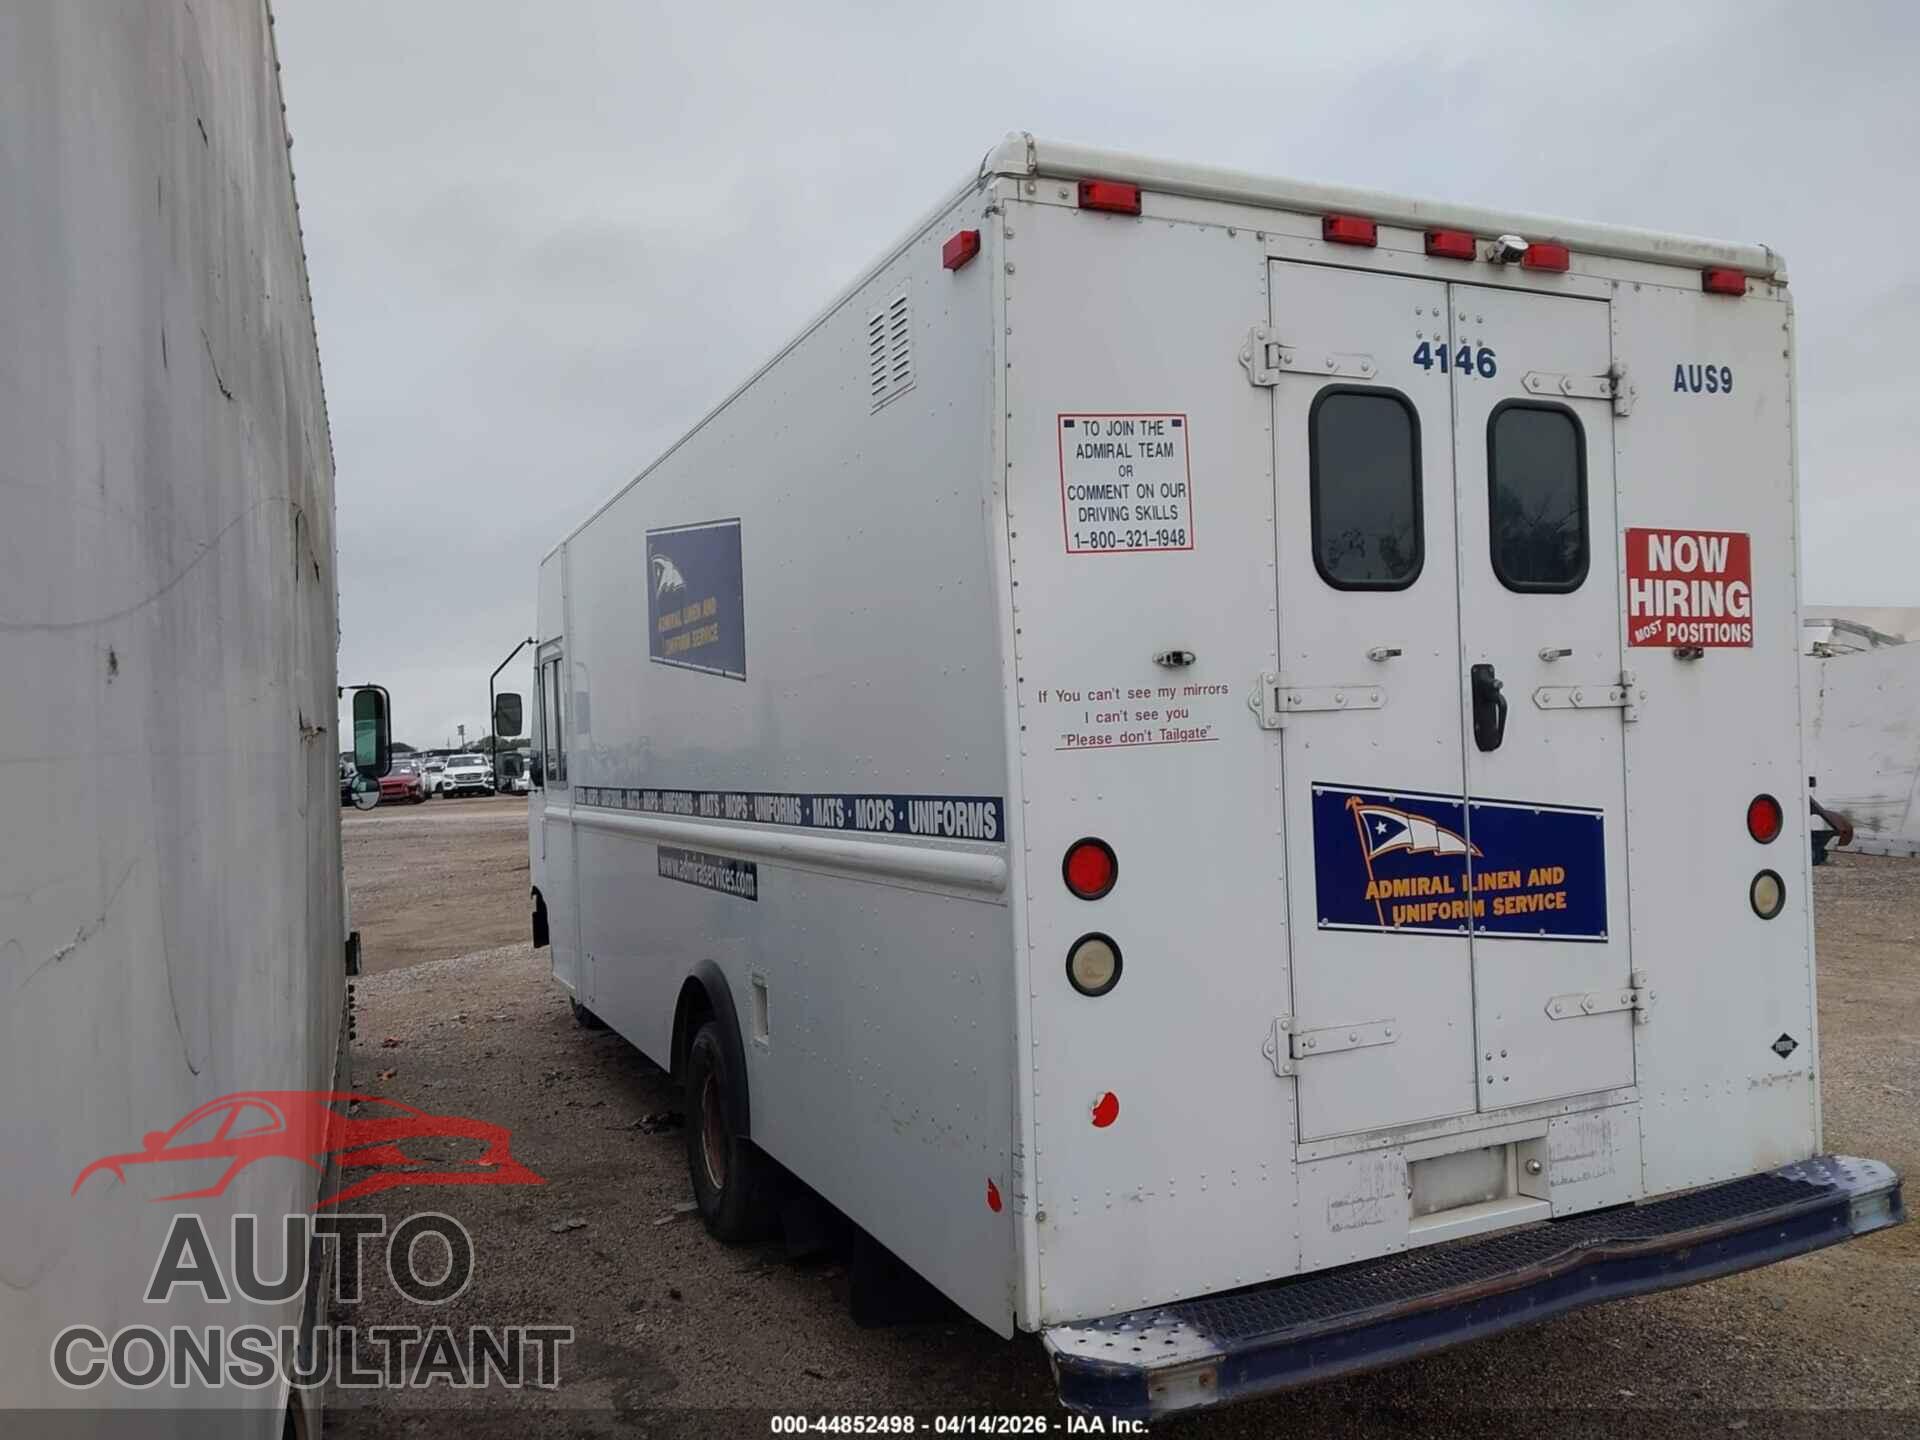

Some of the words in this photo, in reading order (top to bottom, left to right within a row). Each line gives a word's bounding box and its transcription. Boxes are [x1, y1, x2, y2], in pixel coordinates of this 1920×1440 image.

[1412, 341, 1497, 379] 4146
[1673, 364, 1734, 394] AUS9
[1082, 420, 1100, 436] TO
[1106, 420, 1134, 436] JOIN
[1140, 420, 1165, 436] THE
[1076, 443, 1133, 459] ADMIRAL
[1138, 442, 1174, 458] TEAM
[1118, 464, 1134, 478] OR
[1067, 484, 1130, 501] COMMENT
[1136, 483, 1155, 499] ON
[1160, 482, 1187, 499] OUR
[1078, 506, 1130, 523] DRIVING
[1135, 504, 1179, 521] SKILLS
[1073, 528, 1186, 549] 1-800-321-1948
[1647, 534, 1730, 573] NOW
[1629, 577, 1750, 618] HIRING
[1634, 619, 1663, 643] MOST
[1666, 622, 1751, 643] POSITIONS
[1038, 690, 1048, 703] If
[1055, 689, 1081, 703] You
[1087, 687, 1120, 701] can't
[1127, 688, 1151, 699] see
[1157, 687, 1177, 700] my
[1183, 683, 1229, 697] mirrors
[1084, 711, 1089, 724] I
[1095, 710, 1128, 724] can't
[1135, 710, 1159, 721] see
[1165, 708, 1189, 722] you
[1119, 729, 1153, 744] don't
[812, 797, 845, 828] MATS
[855, 799, 895, 832] MOPS
[908, 800, 997, 840] UNIFORMS
[1365, 876, 1455, 900] ADMIRAL
[1462, 869, 1521, 893] LINEN
[1527, 866, 1565, 888] AND
[1392, 898, 1485, 924] UNIFORM
[1493, 891, 1567, 917] SERVICE
